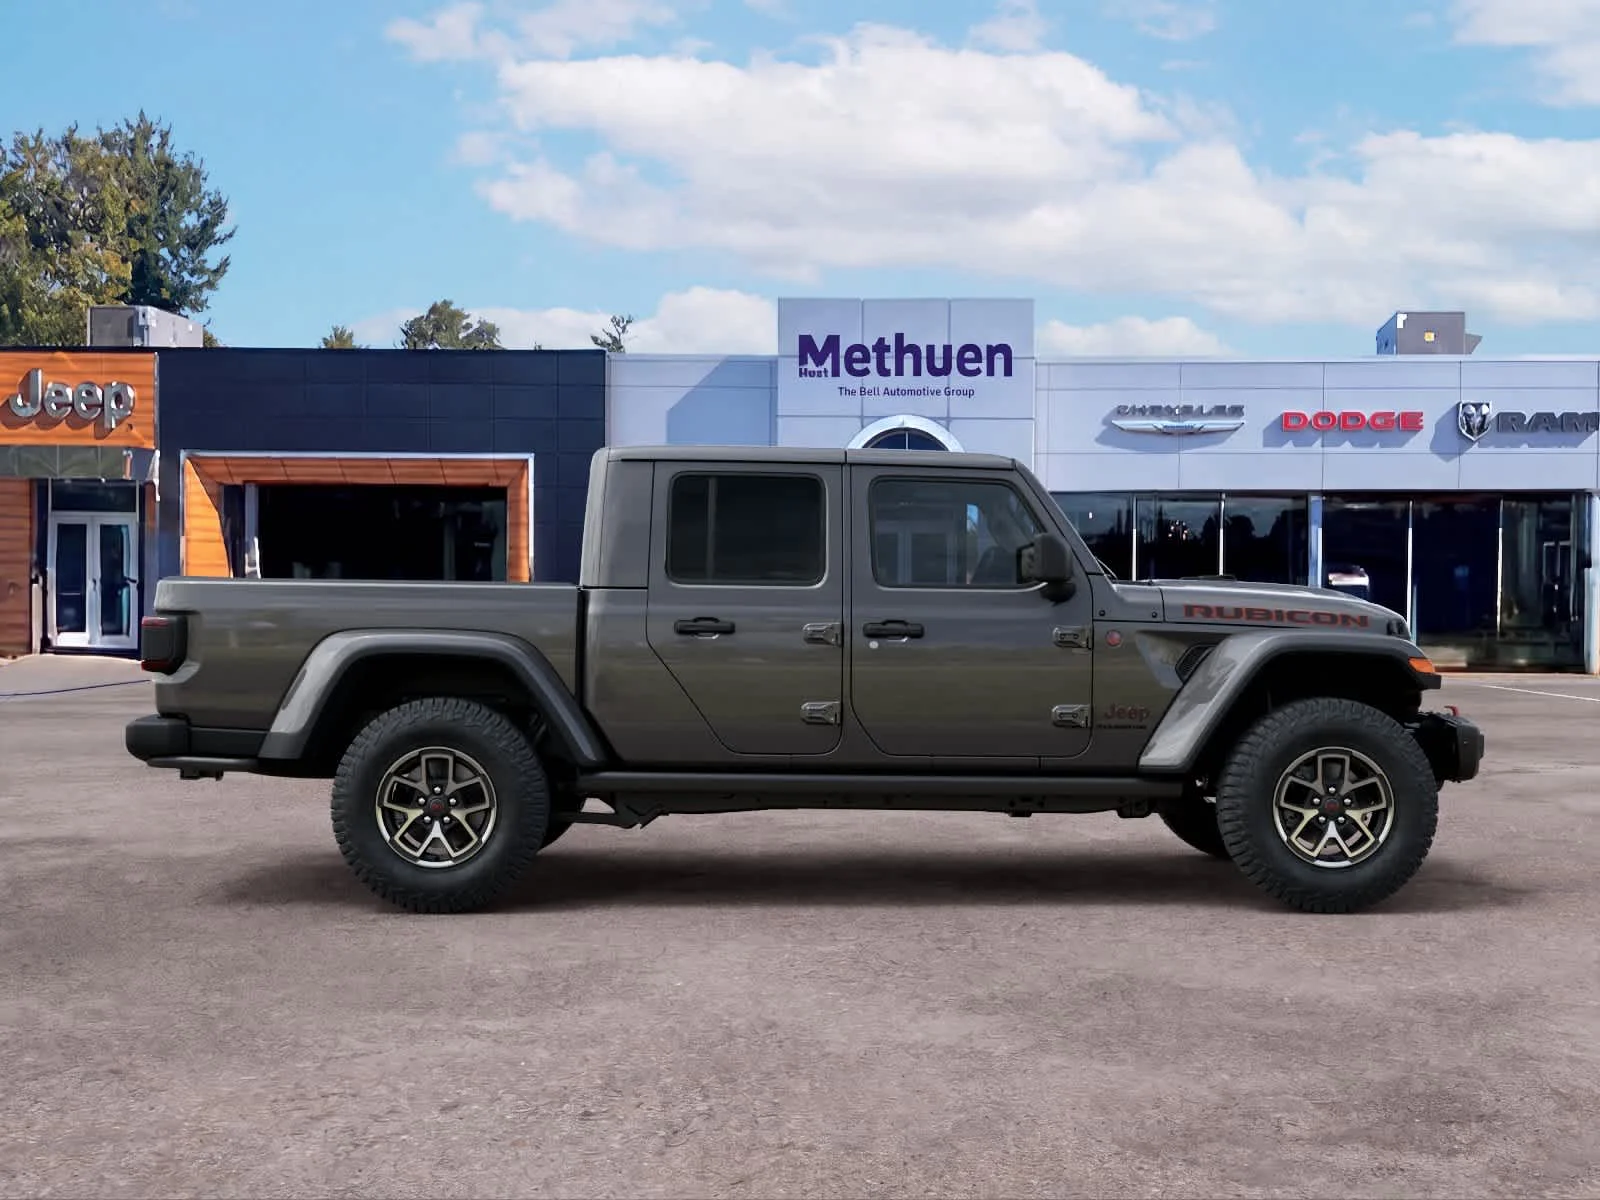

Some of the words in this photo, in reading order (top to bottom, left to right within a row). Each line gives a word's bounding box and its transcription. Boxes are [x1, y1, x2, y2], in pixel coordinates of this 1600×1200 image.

[798, 332, 1013, 378] Methuen
[8, 367, 136, 429] Jeep
[838, 386, 857, 397] The
[859, 386, 880, 397] Bell
[883, 386, 942, 397] Automotive
[943, 386, 975, 399] Group
[1281, 411, 1424, 433] DODGE
[1496, 411, 1600, 433] RAM
[1184, 604, 1369, 628] RUBICON
[1104, 702, 1150, 722] Jeep
